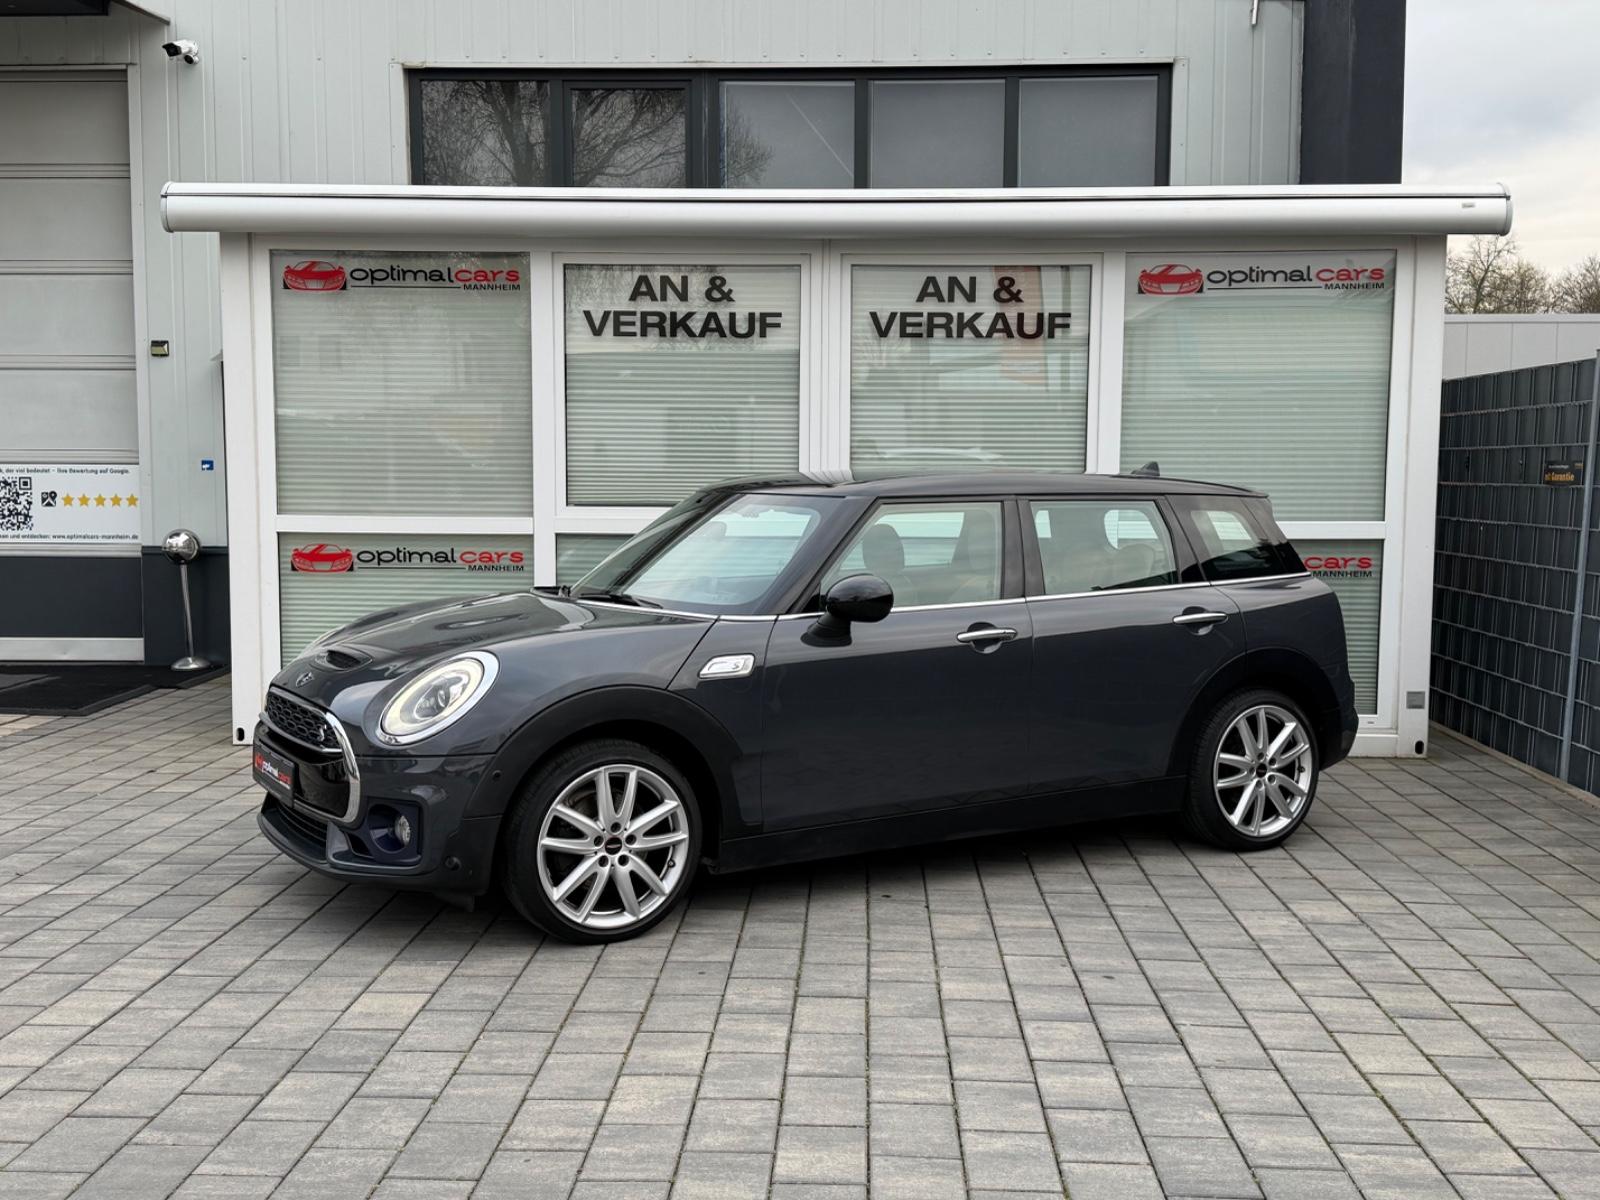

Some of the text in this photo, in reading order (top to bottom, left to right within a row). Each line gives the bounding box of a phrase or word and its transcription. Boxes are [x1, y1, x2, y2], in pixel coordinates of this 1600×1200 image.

[463, 283, 521, 291] MANNHEIM
[628, 274, 735, 302] AN &
[915, 276, 1024, 303] AN &
[1324, 282, 1385, 290] MANNHEIM
[583, 310, 782, 338] VERKAUF
[869, 311, 1072, 339] VERKAUF
[69, 467, 98, 475] Bewertung
[1312, 570, 1373, 578] MANNHEIM
